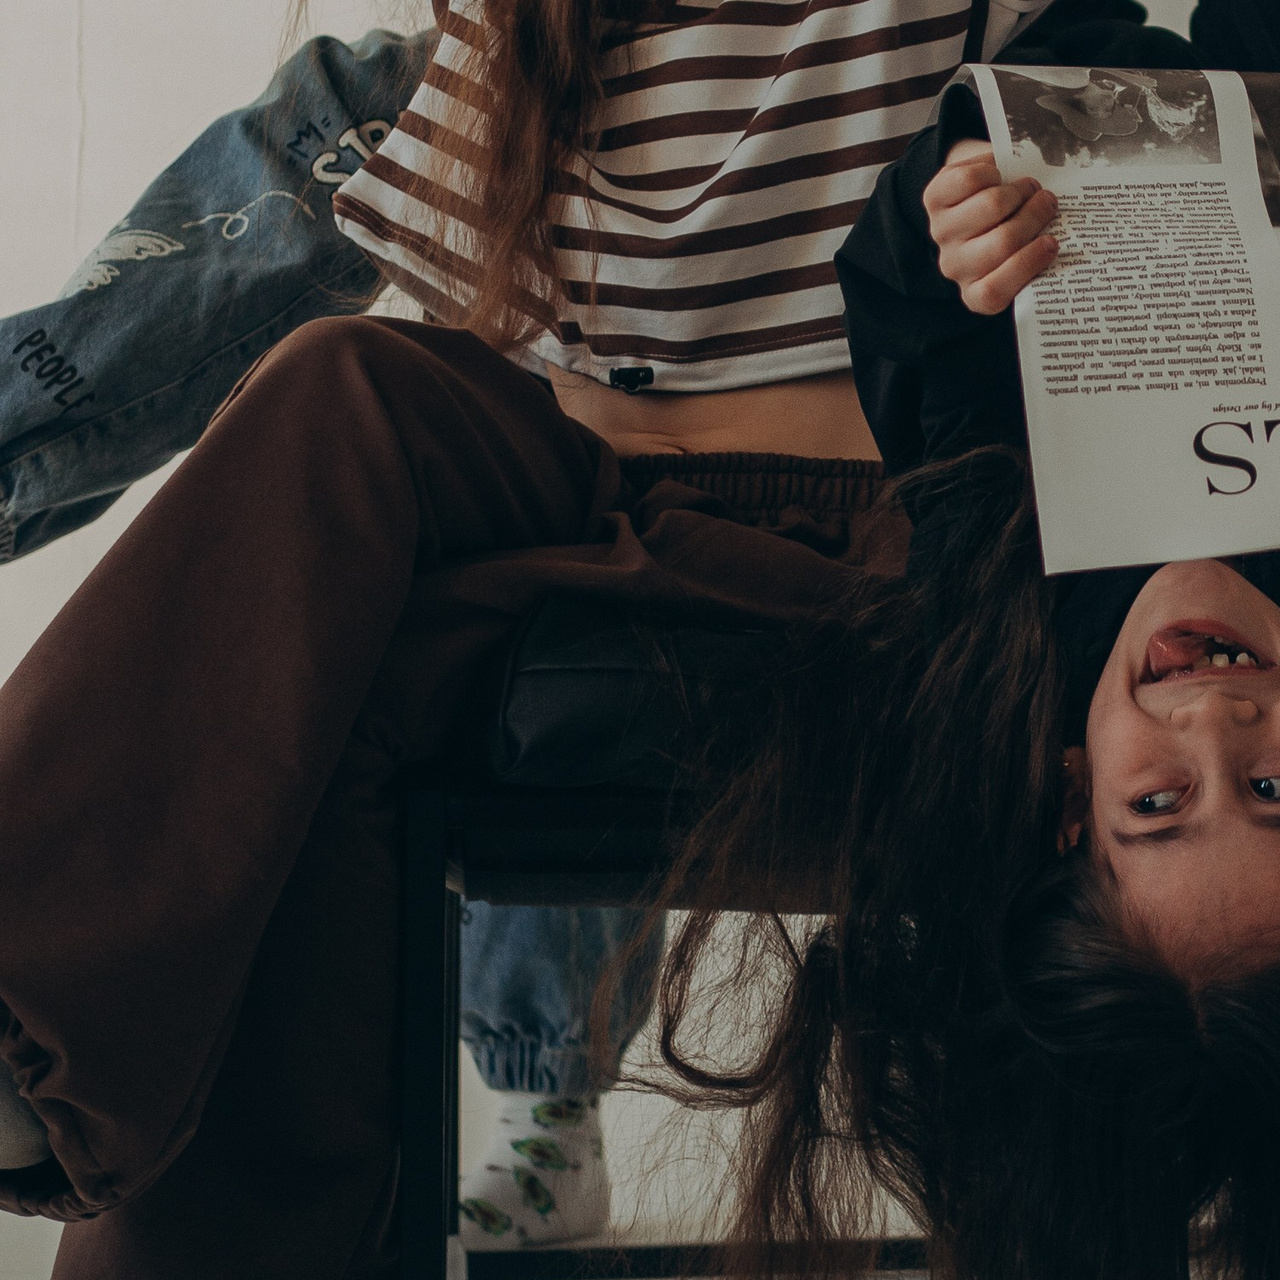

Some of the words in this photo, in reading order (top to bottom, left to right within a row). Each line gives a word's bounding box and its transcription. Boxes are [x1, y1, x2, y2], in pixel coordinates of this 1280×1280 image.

[1124, 183, 1177, 191] kiedykolwiek
[1179, 181, 1198, 189] jaka
[1188, 279, 1197, 287] ja
[1221, 298, 1255, 306] Helmut
[1071, 305, 1096, 315] przed
[1202, 309, 1221, 319] tych
[1230, 309, 1257, 317] Jedna
[1083, 317, 1099, 325] nad
[1153, 324, 1181, 332] trzeba
[1115, 338, 1118, 346] i
[1120, 337, 1147, 345] druku
[1149, 336, 1160, 344] do
[1185, 344, 1213, 353] bylem
[1216, 343, 1242, 353] Kiedy
[1167, 356, 1219, 365] powinienem
[1236, 354, 1246, 363] ja
[1259, 355, 1263, 363] I
[1090, 362, 1104, 370] nie
[12, 327, 96, 417] PEOPLE
[1167, 370, 1185, 378] uda
[1189, 369, 1218, 377] daleko
[1222, 366, 1238, 376] jak
[1080, 387, 1092, 395] do
[1145, 383, 1179, 391] Helmut
[1211, 402, 1242, 414] Design
[1243, 403, 1260, 411] our
[1261, 401, 1273, 412] by
